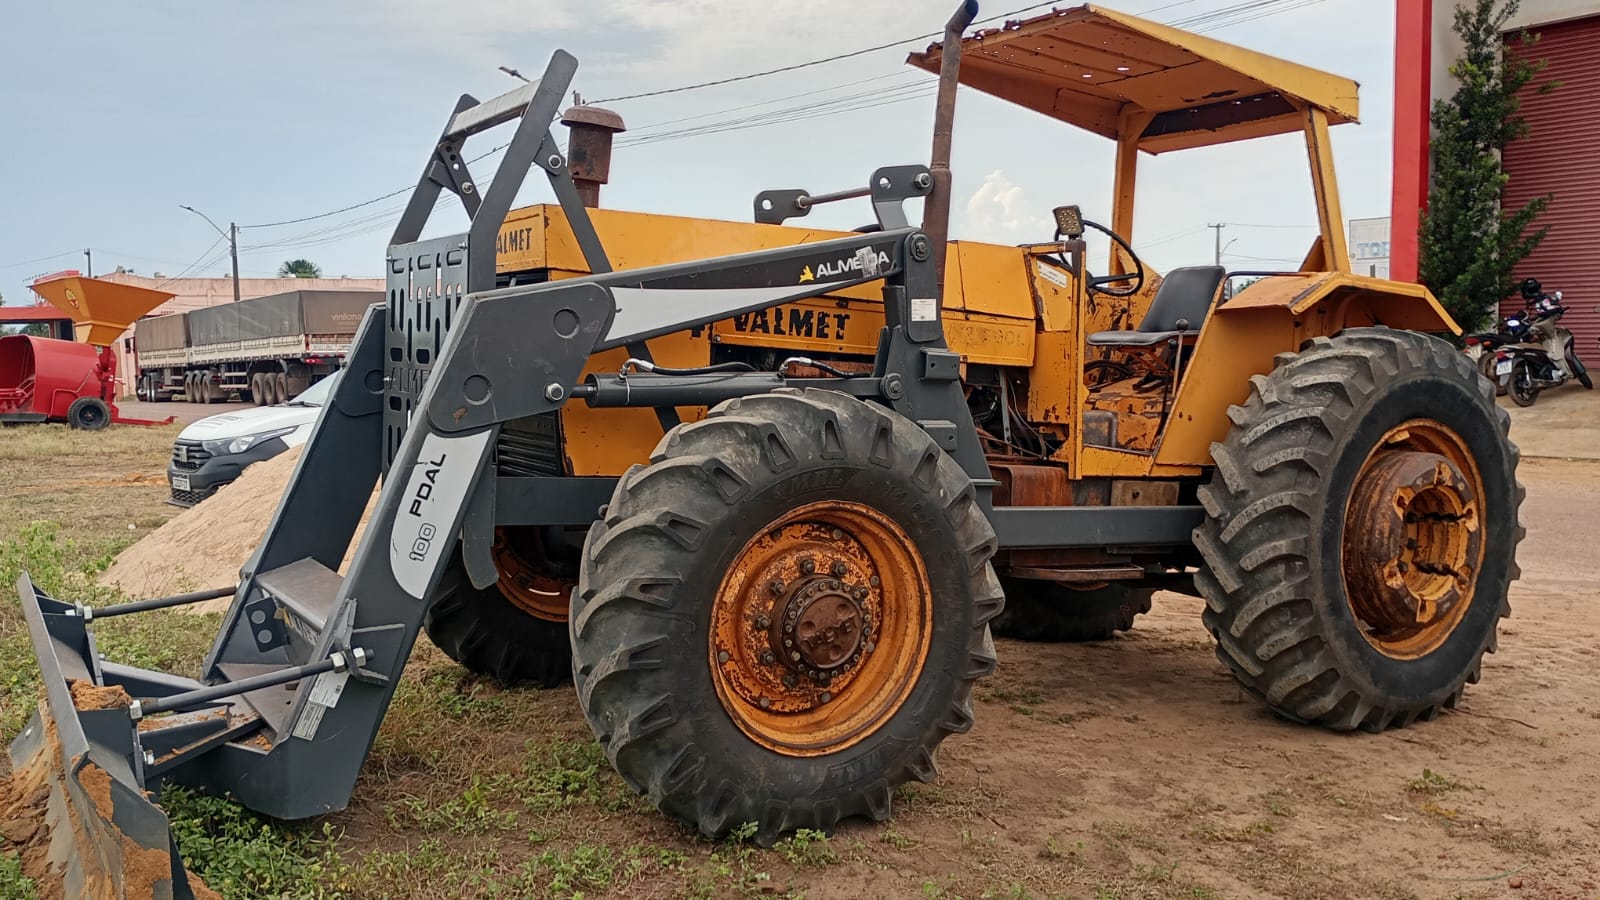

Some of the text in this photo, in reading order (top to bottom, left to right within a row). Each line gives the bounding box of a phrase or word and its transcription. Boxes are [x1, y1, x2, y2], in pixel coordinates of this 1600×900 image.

[496, 227, 532, 254] ALMET
[733, 306, 850, 340] VALMET
[409, 453, 446, 517] PDAL
[408, 522, 437, 562] 100
